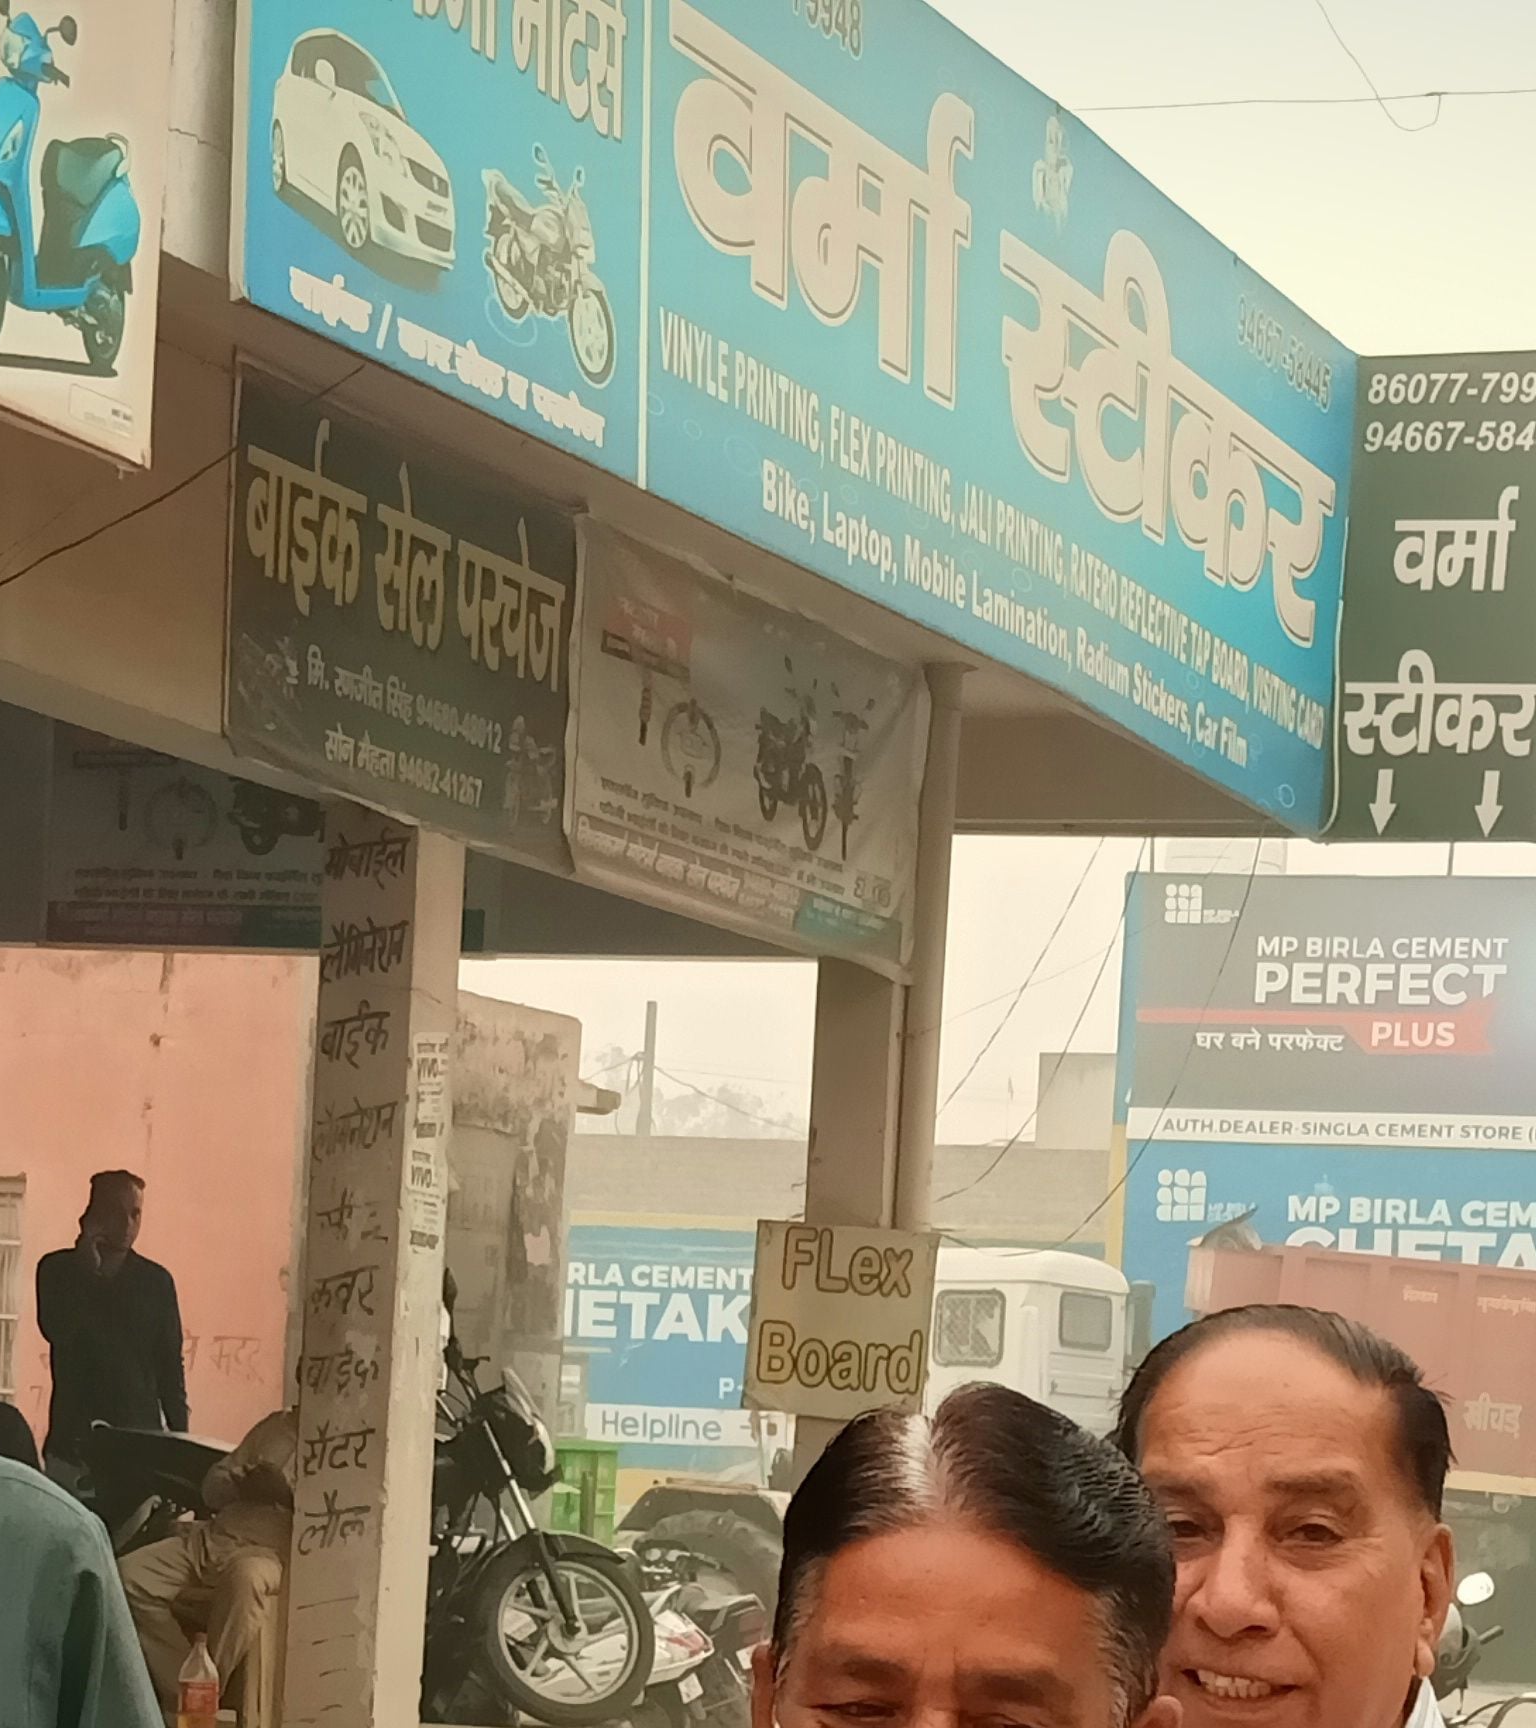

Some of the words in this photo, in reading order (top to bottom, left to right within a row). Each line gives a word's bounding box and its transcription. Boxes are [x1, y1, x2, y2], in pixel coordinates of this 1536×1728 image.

[669, 0, 975, 410] वर्मा
[1000, 228, 1336, 648] स्टीकर
[659, 306, 729, 404] VINYLE
[734, 350, 824, 460] PRINTING,
[831, 406, 871, 482] FLEX
[875, 429, 955, 525] PRINTING,
[958, 482, 991, 554] JALI
[1120, 576, 1189, 666] REFLECTIVE
[1393, 486, 1520, 592] वर्मा
[375, 462, 451, 650] सेल
[458, 517, 565, 692] परचेज
[762, 459, 815, 544] Bike,
[822, 496, 897, 585] Laptop,
[904, 535, 967, 609] Mobile
[971, 578, 1072, 674] Lamination,
[1076, 627, 1130, 698] Radium
[1133, 663, 1191, 744] Stickers,
[1195, 702, 1219, 744] Car
[1220, 717, 1248, 768] Film
[1256, 936, 1298, 958] MP
[1306, 937, 1385, 959] BIRLA
[1392, 938, 1509, 960] CEMENT
[1254, 962, 1508, 1006] PERFECT
[1196, 1030, 1223, 1051] घर
[1371, 1021, 1456, 1048] PLUS
[1375, 1124, 1454, 1141] CEMENT
[1460, 1125, 1523, 1142] STORE
[1288, 1195, 1341, 1222] MP
[1349, 1197, 1452, 1226] BIRLA
[567, 1262, 623, 1286] RLA
[632, 1264, 753, 1291] CEMENT
[565, 1287, 750, 1344] ETAK
[757, 1320, 923, 1395] Board
[602, 1411, 722, 1442] Helpline
